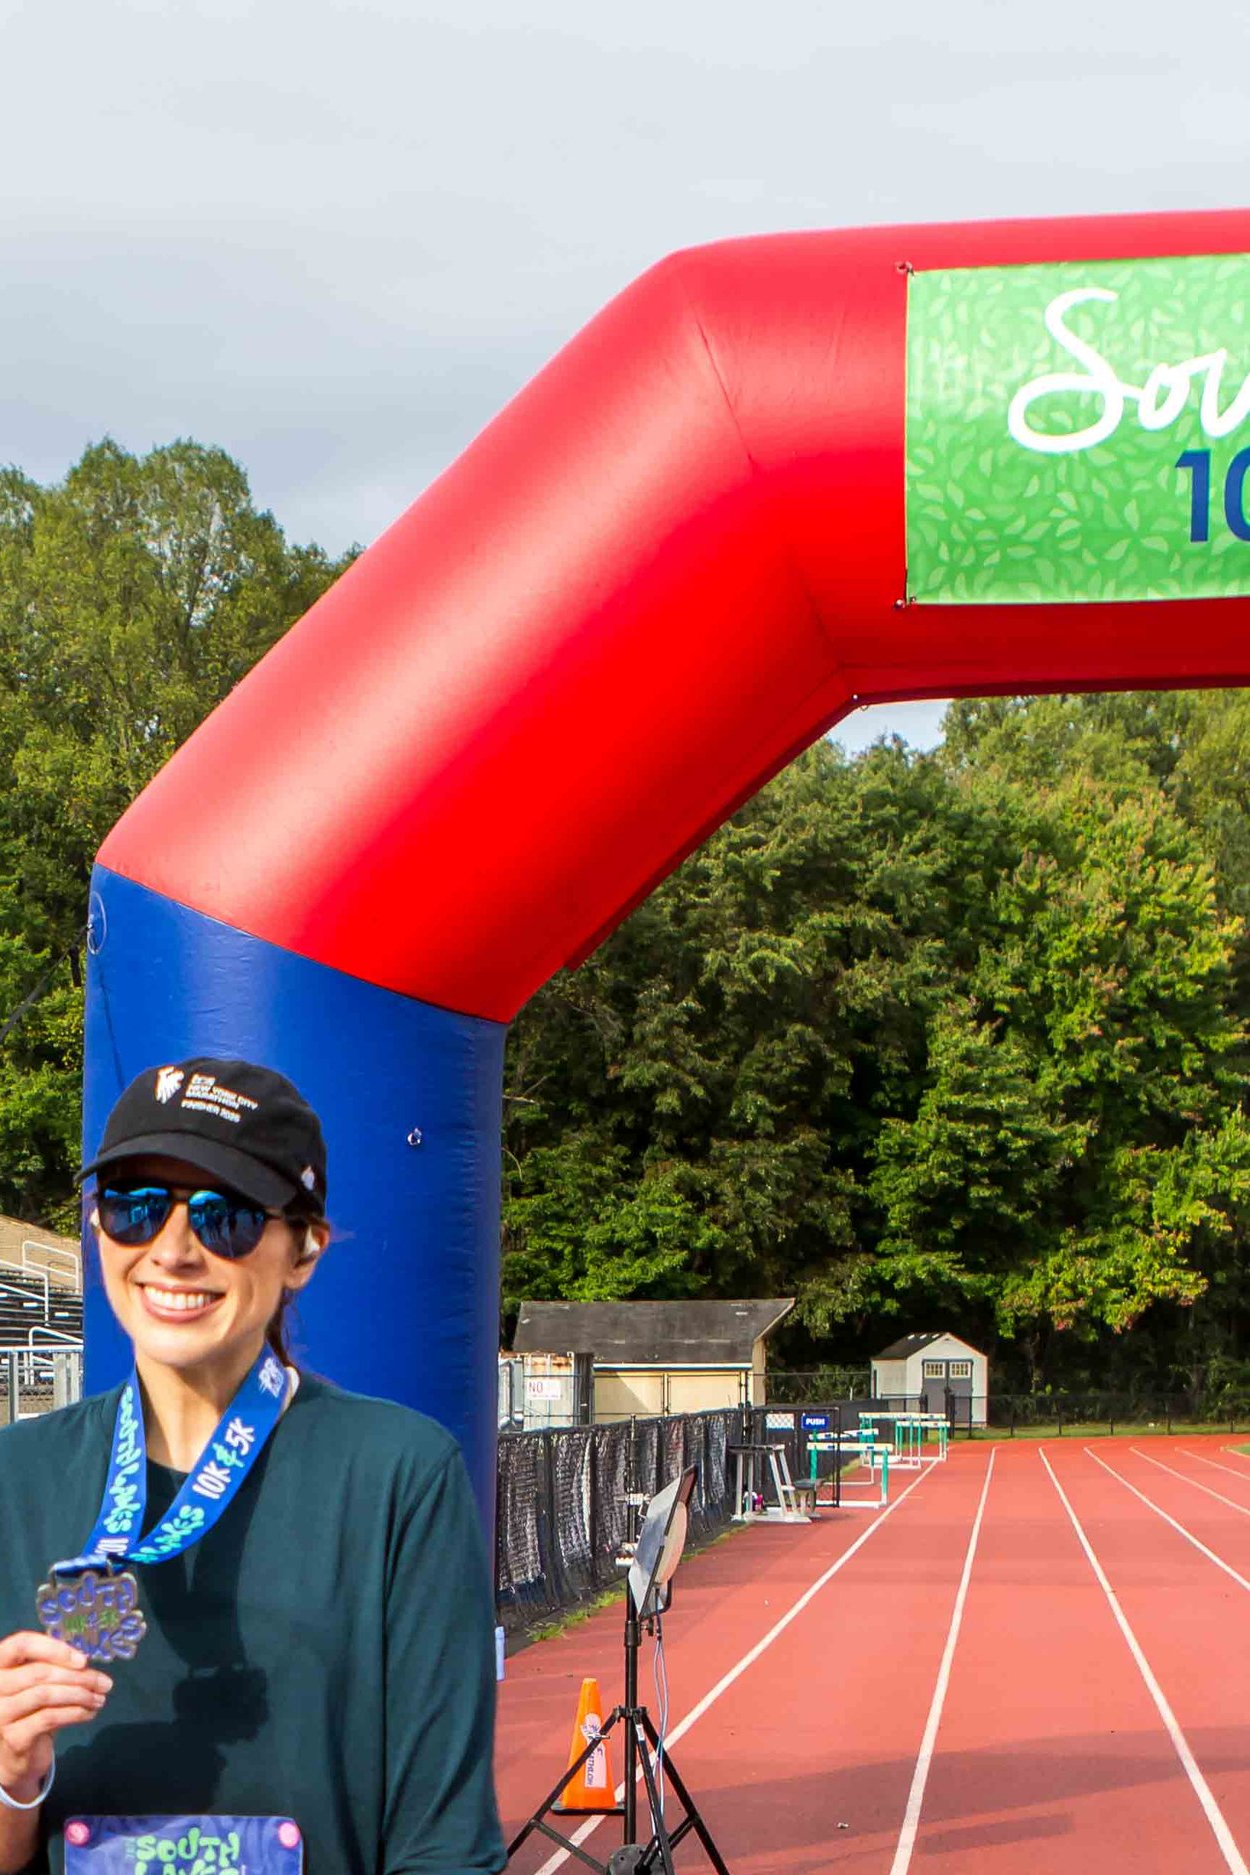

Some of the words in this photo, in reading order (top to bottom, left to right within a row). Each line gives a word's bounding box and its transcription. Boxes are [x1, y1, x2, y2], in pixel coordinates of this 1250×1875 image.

[529, 1381, 543, 1393] NO
[805, 1418, 825, 1426] PUSH
[192, 1461, 232, 1500] 10K
[225, 1417, 255, 1456] 5K
[103, 1462, 141, 1534] LAKES
[94, 1537, 129, 1556] 10
[135, 1827, 240, 1867] SOUTH
